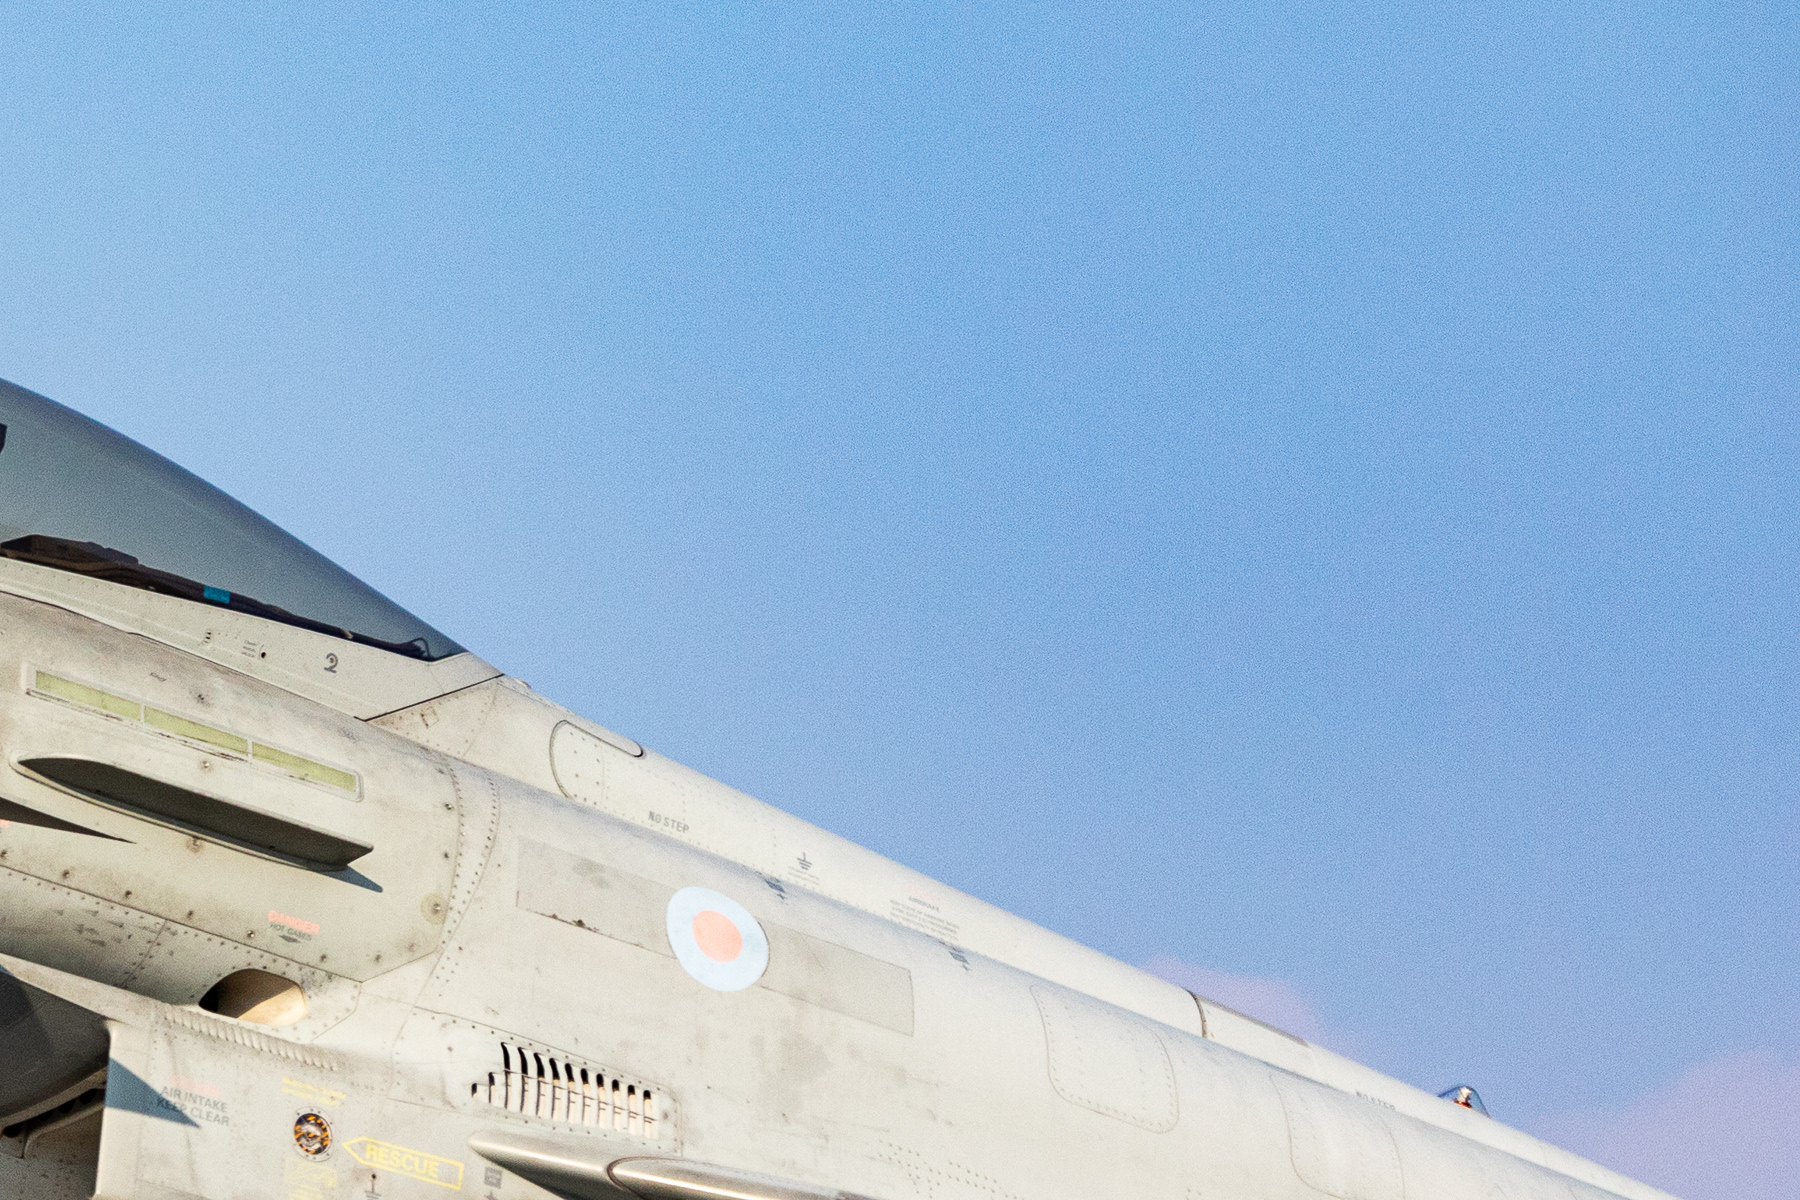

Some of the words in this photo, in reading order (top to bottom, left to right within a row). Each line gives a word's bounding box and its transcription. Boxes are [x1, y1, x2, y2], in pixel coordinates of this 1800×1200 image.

[324, 652, 339, 674] 2
[648, 810, 662, 824] NO
[663, 816, 690, 833] STEP
[270, 922, 285, 932] HOT
[287, 927, 312, 941] GASES
[157, 1098, 188, 1112] KEEP
[190, 1106, 230, 1126] CLEAR
[161, 1086, 183, 1100] AIR
[184, 1091, 229, 1113] INTAKE
[365, 1143, 440, 1178] RESCUE
